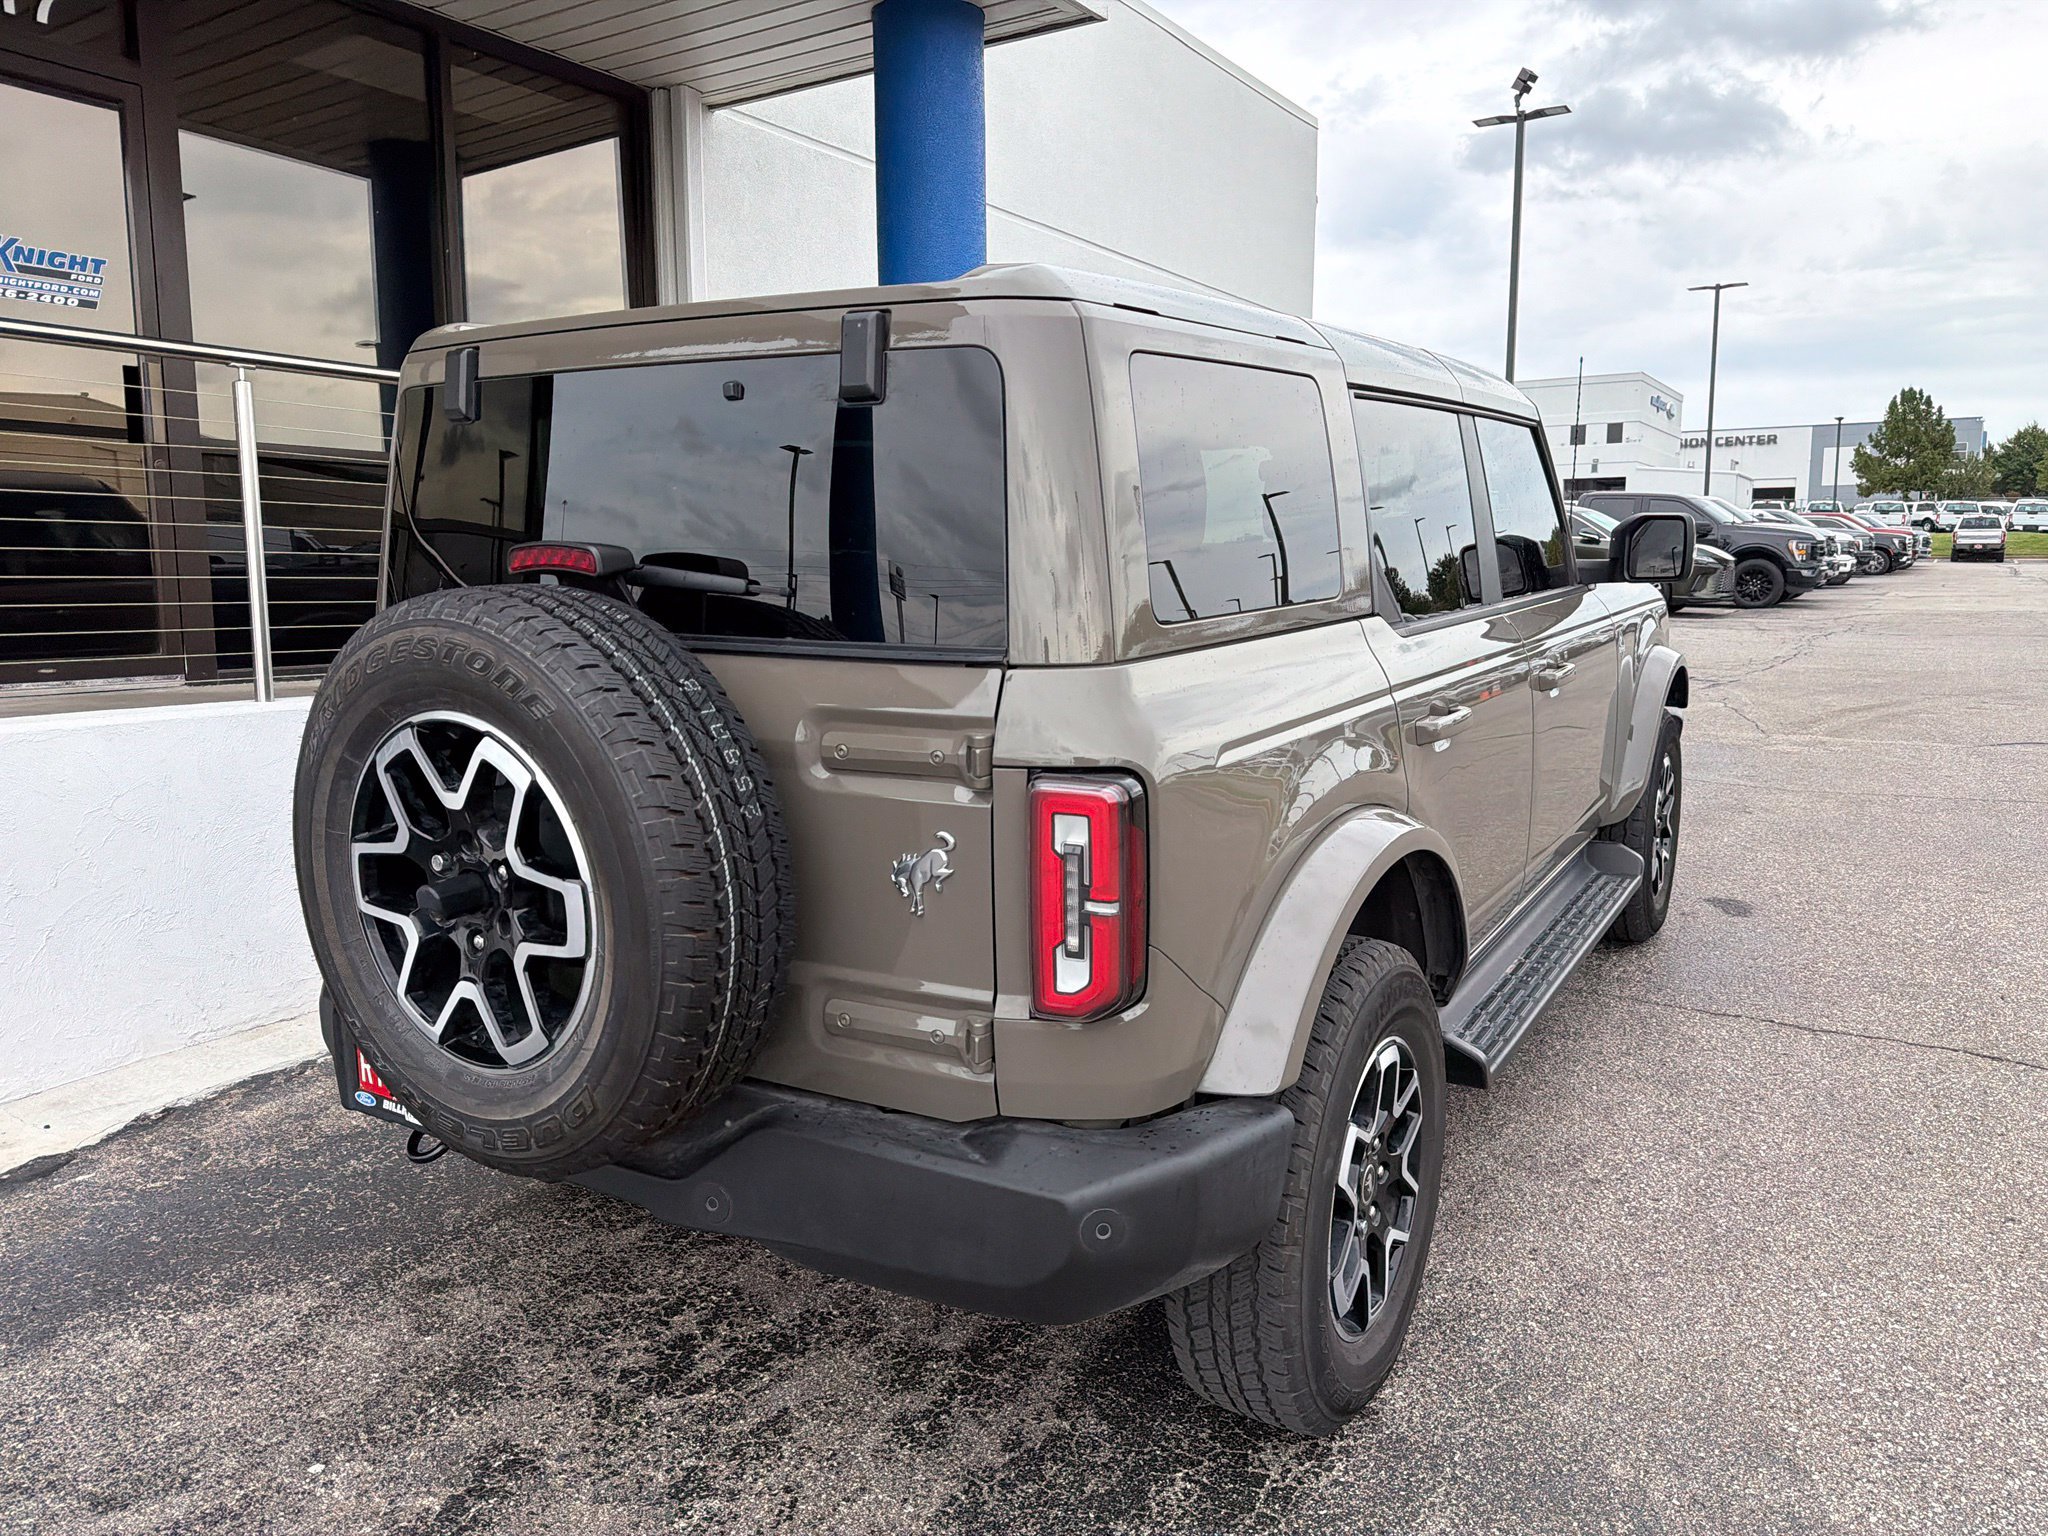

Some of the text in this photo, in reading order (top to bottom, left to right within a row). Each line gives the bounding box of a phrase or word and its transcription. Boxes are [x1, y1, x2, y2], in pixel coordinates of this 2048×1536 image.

[70, 274, 102, 285] FORD
[1715, 433, 1778, 448] CENTER
[304, 634, 558, 766] BRIDGESTONE
[400, 1083, 597, 1151] DUELER
